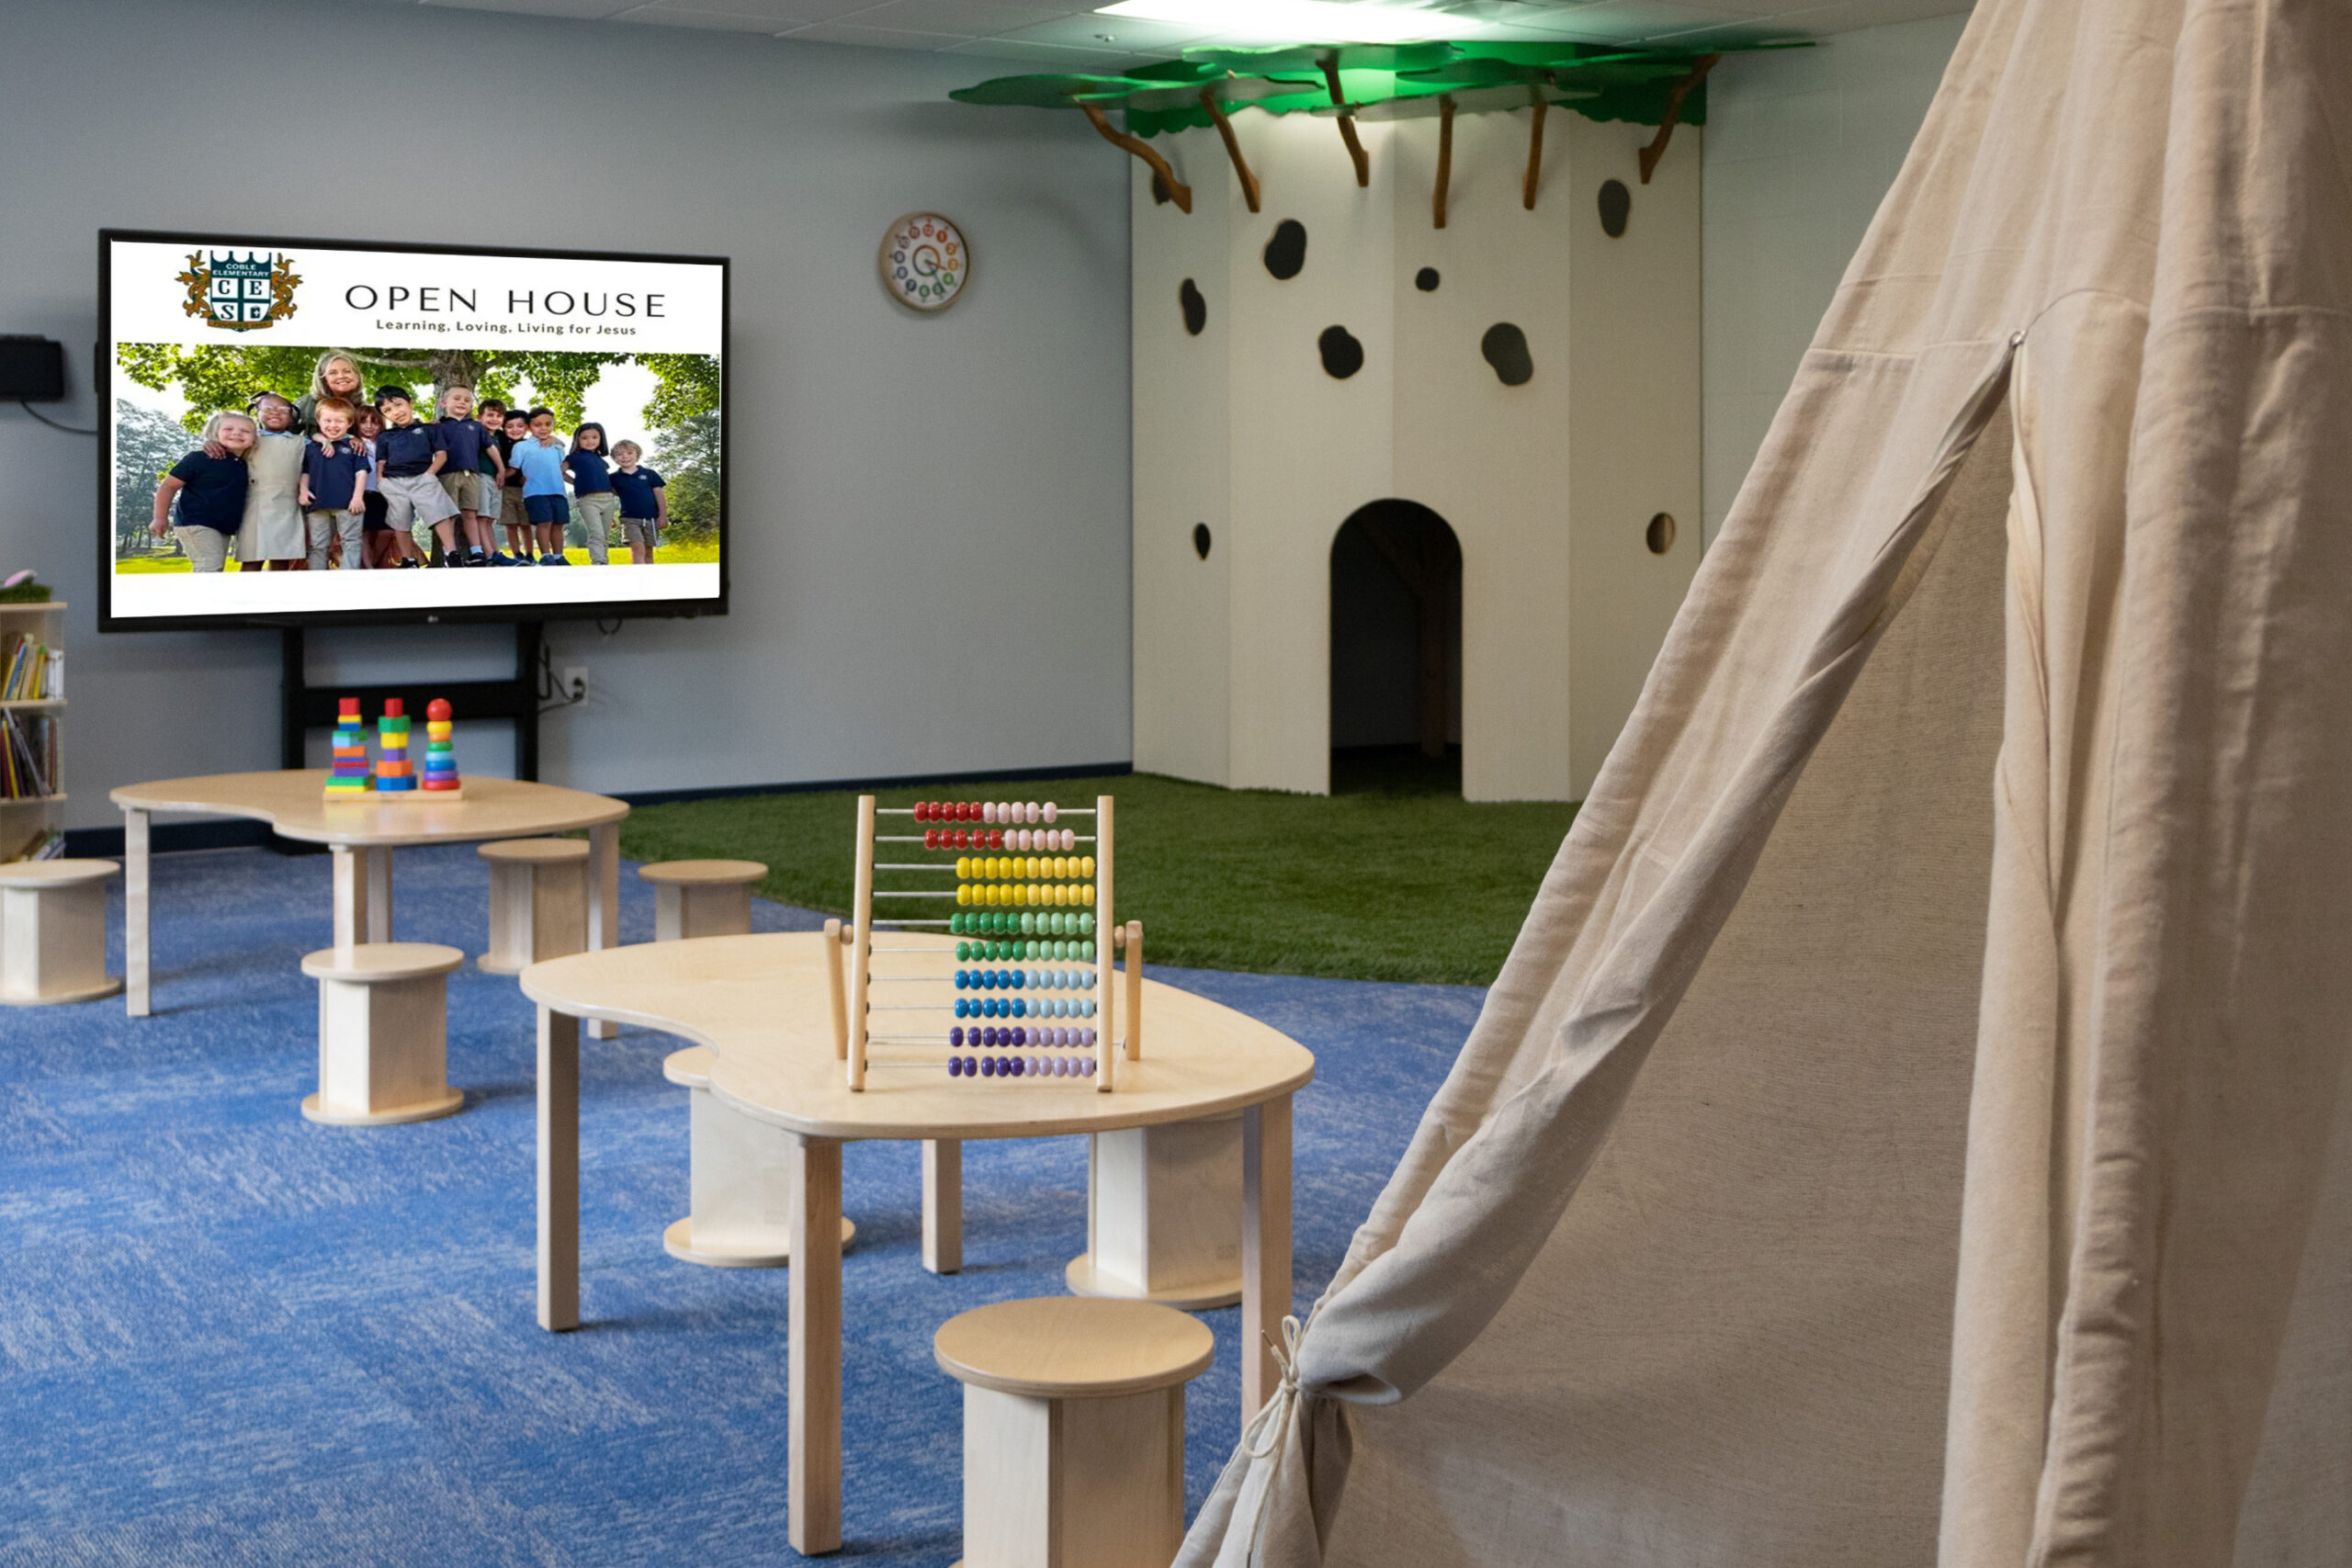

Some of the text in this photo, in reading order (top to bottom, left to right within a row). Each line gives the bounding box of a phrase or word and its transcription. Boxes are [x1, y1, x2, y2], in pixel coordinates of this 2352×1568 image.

[218, 279, 263, 296] C E
[345, 285, 666, 318] OPEN HOUSE
[220, 304, 234, 321] S
[376, 319, 637, 335] Learning, Loving, Living for Jesus
